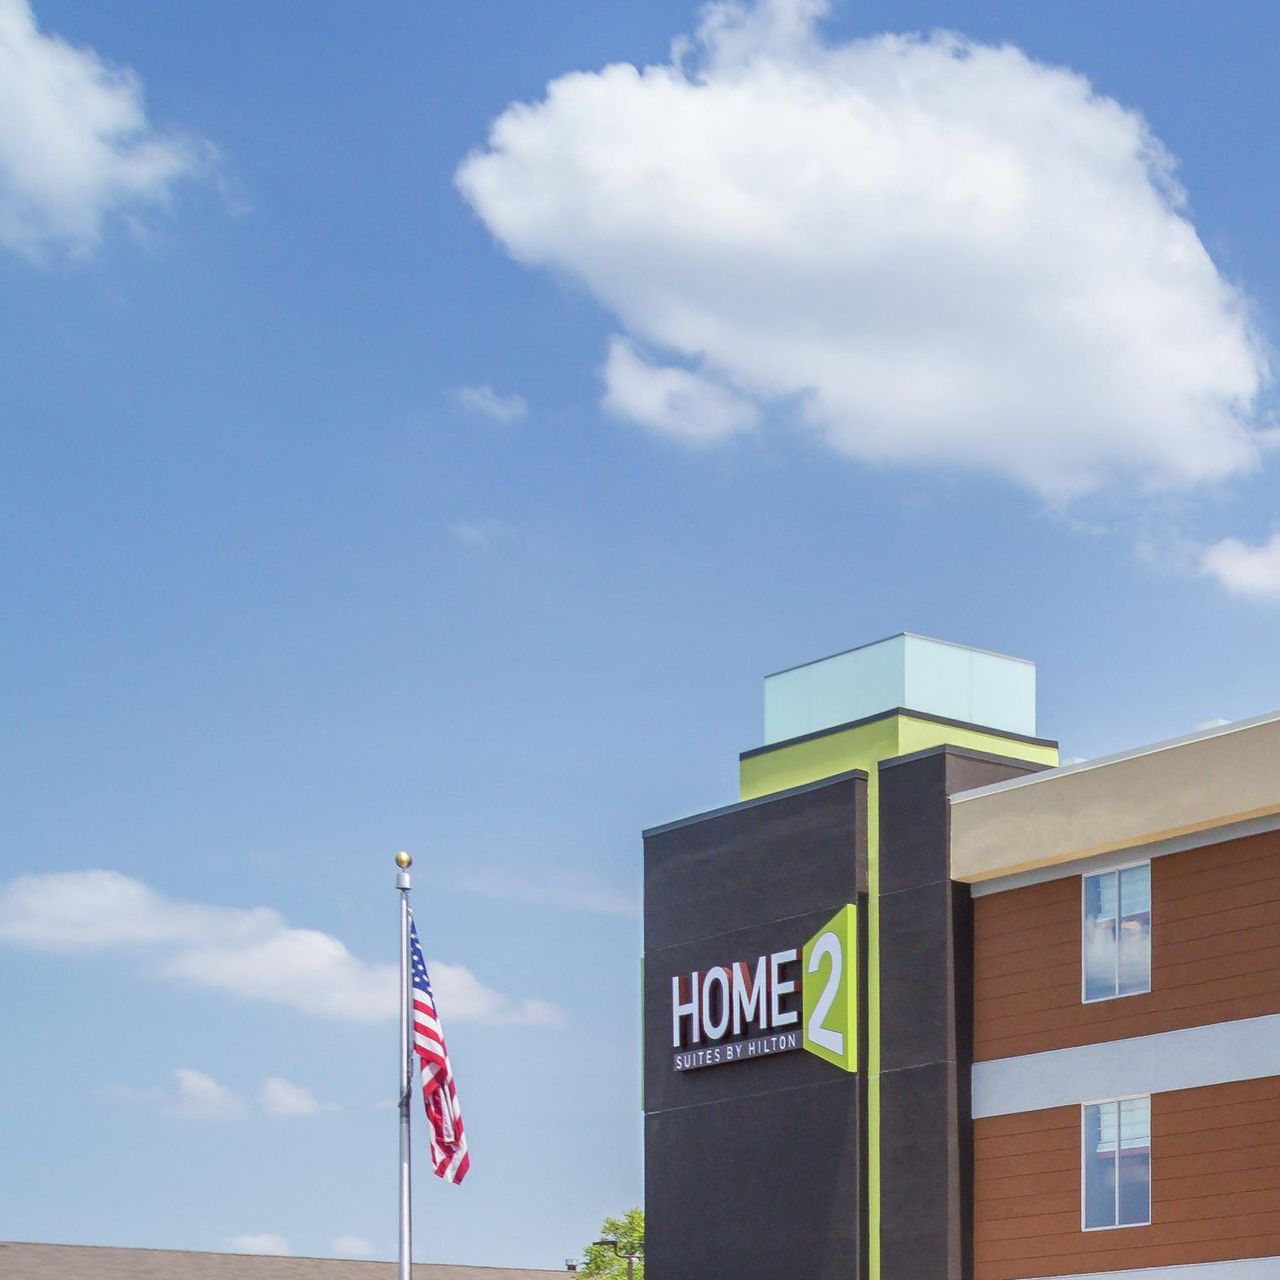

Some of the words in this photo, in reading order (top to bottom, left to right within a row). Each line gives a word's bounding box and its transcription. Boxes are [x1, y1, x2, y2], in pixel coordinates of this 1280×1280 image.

[672, 949, 798, 1048] HOME
[808, 932, 844, 1056] 2
[676, 1049, 721, 1070] SUITES
[726, 1043, 743, 1060] BY
[748, 1033, 797, 1056] HILTON
